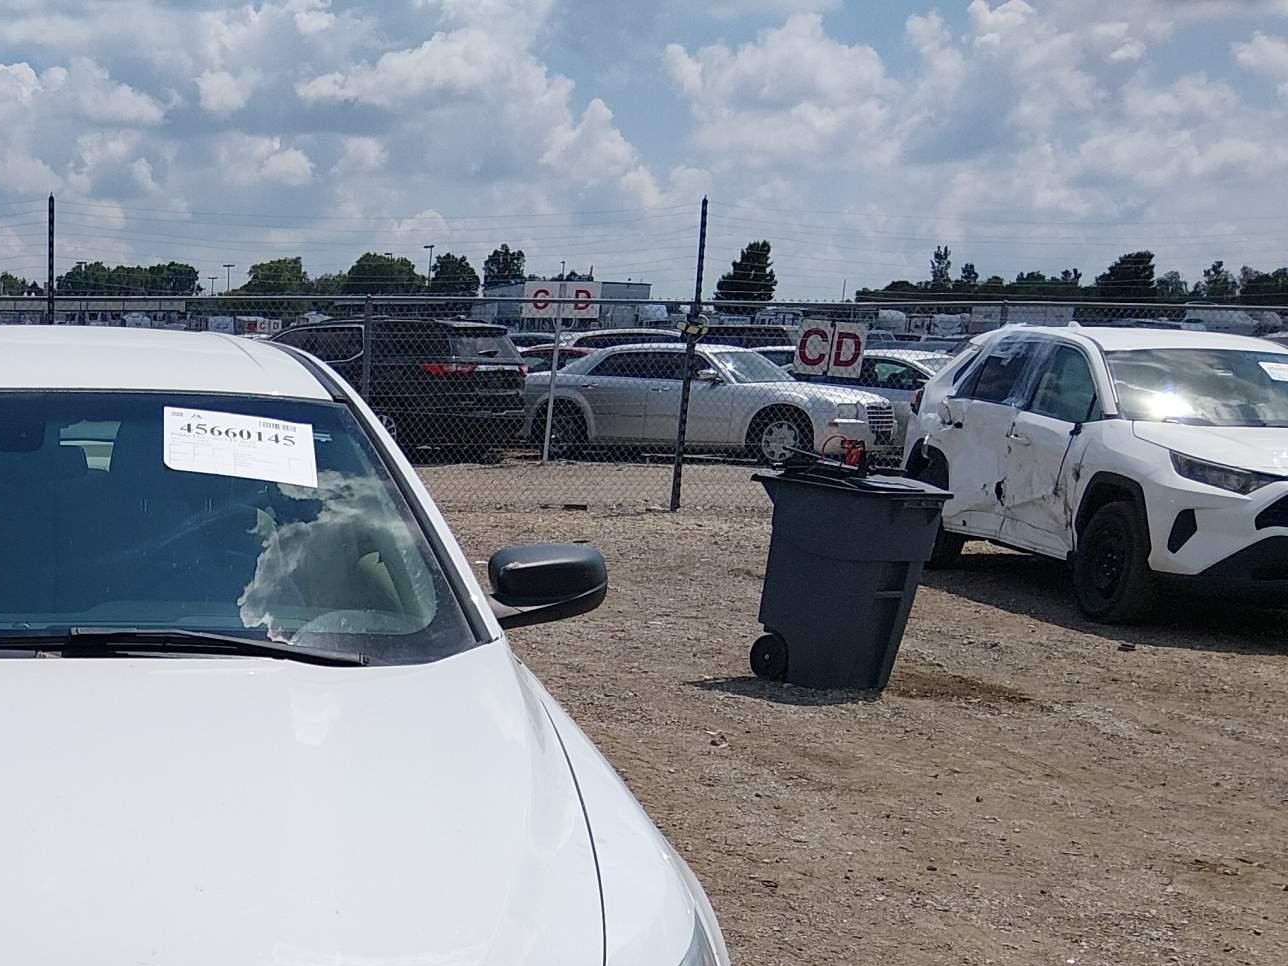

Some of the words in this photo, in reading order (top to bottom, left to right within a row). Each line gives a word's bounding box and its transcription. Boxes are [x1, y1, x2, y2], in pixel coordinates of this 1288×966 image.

[533, 289, 550, 310] C
[573, 289, 592, 310] D
[179, 422, 297, 447] 45660145
